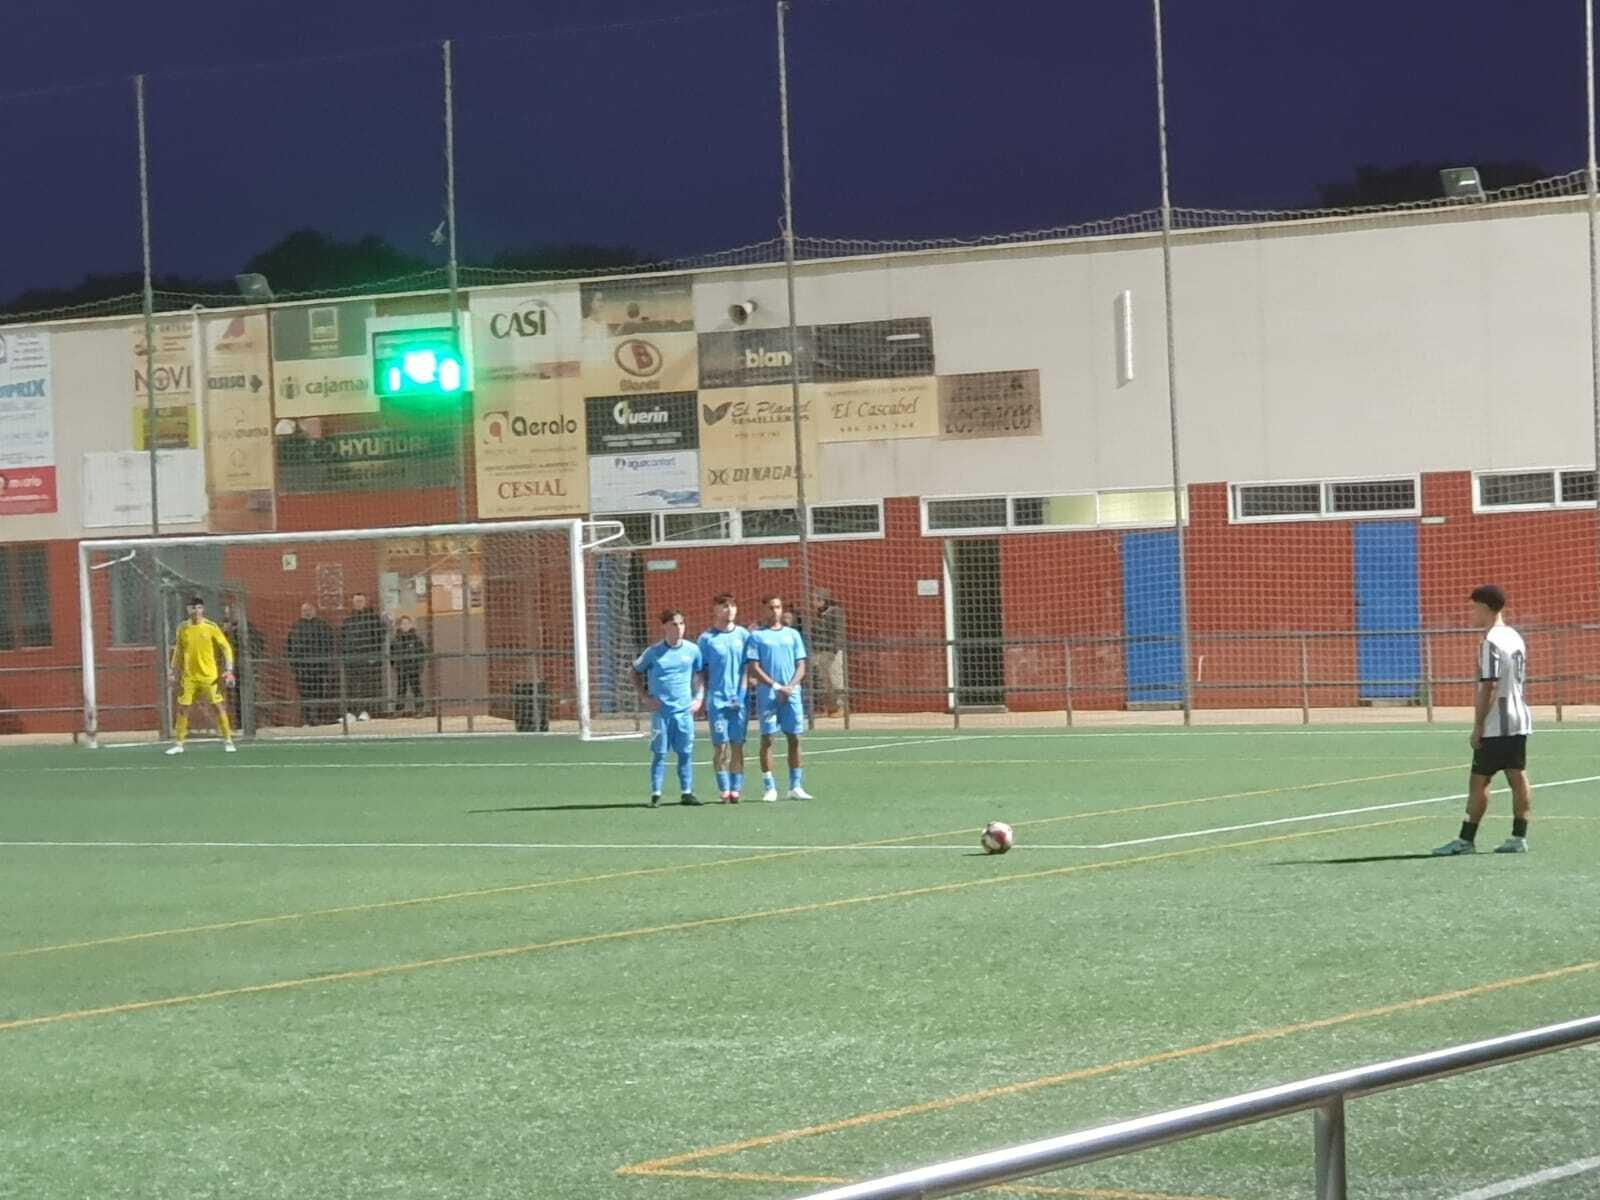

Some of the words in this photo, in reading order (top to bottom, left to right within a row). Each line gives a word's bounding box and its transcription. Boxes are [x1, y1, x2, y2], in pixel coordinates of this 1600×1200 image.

[489, 309, 546, 339] CASI
[133, 365, 192, 392] NOVI
[858, 397, 920, 417] Cascabel
[732, 413, 810, 425] SEMILLERS
[733, 465, 806, 482] DINAGA
[497, 479, 568, 500] CESIAL
